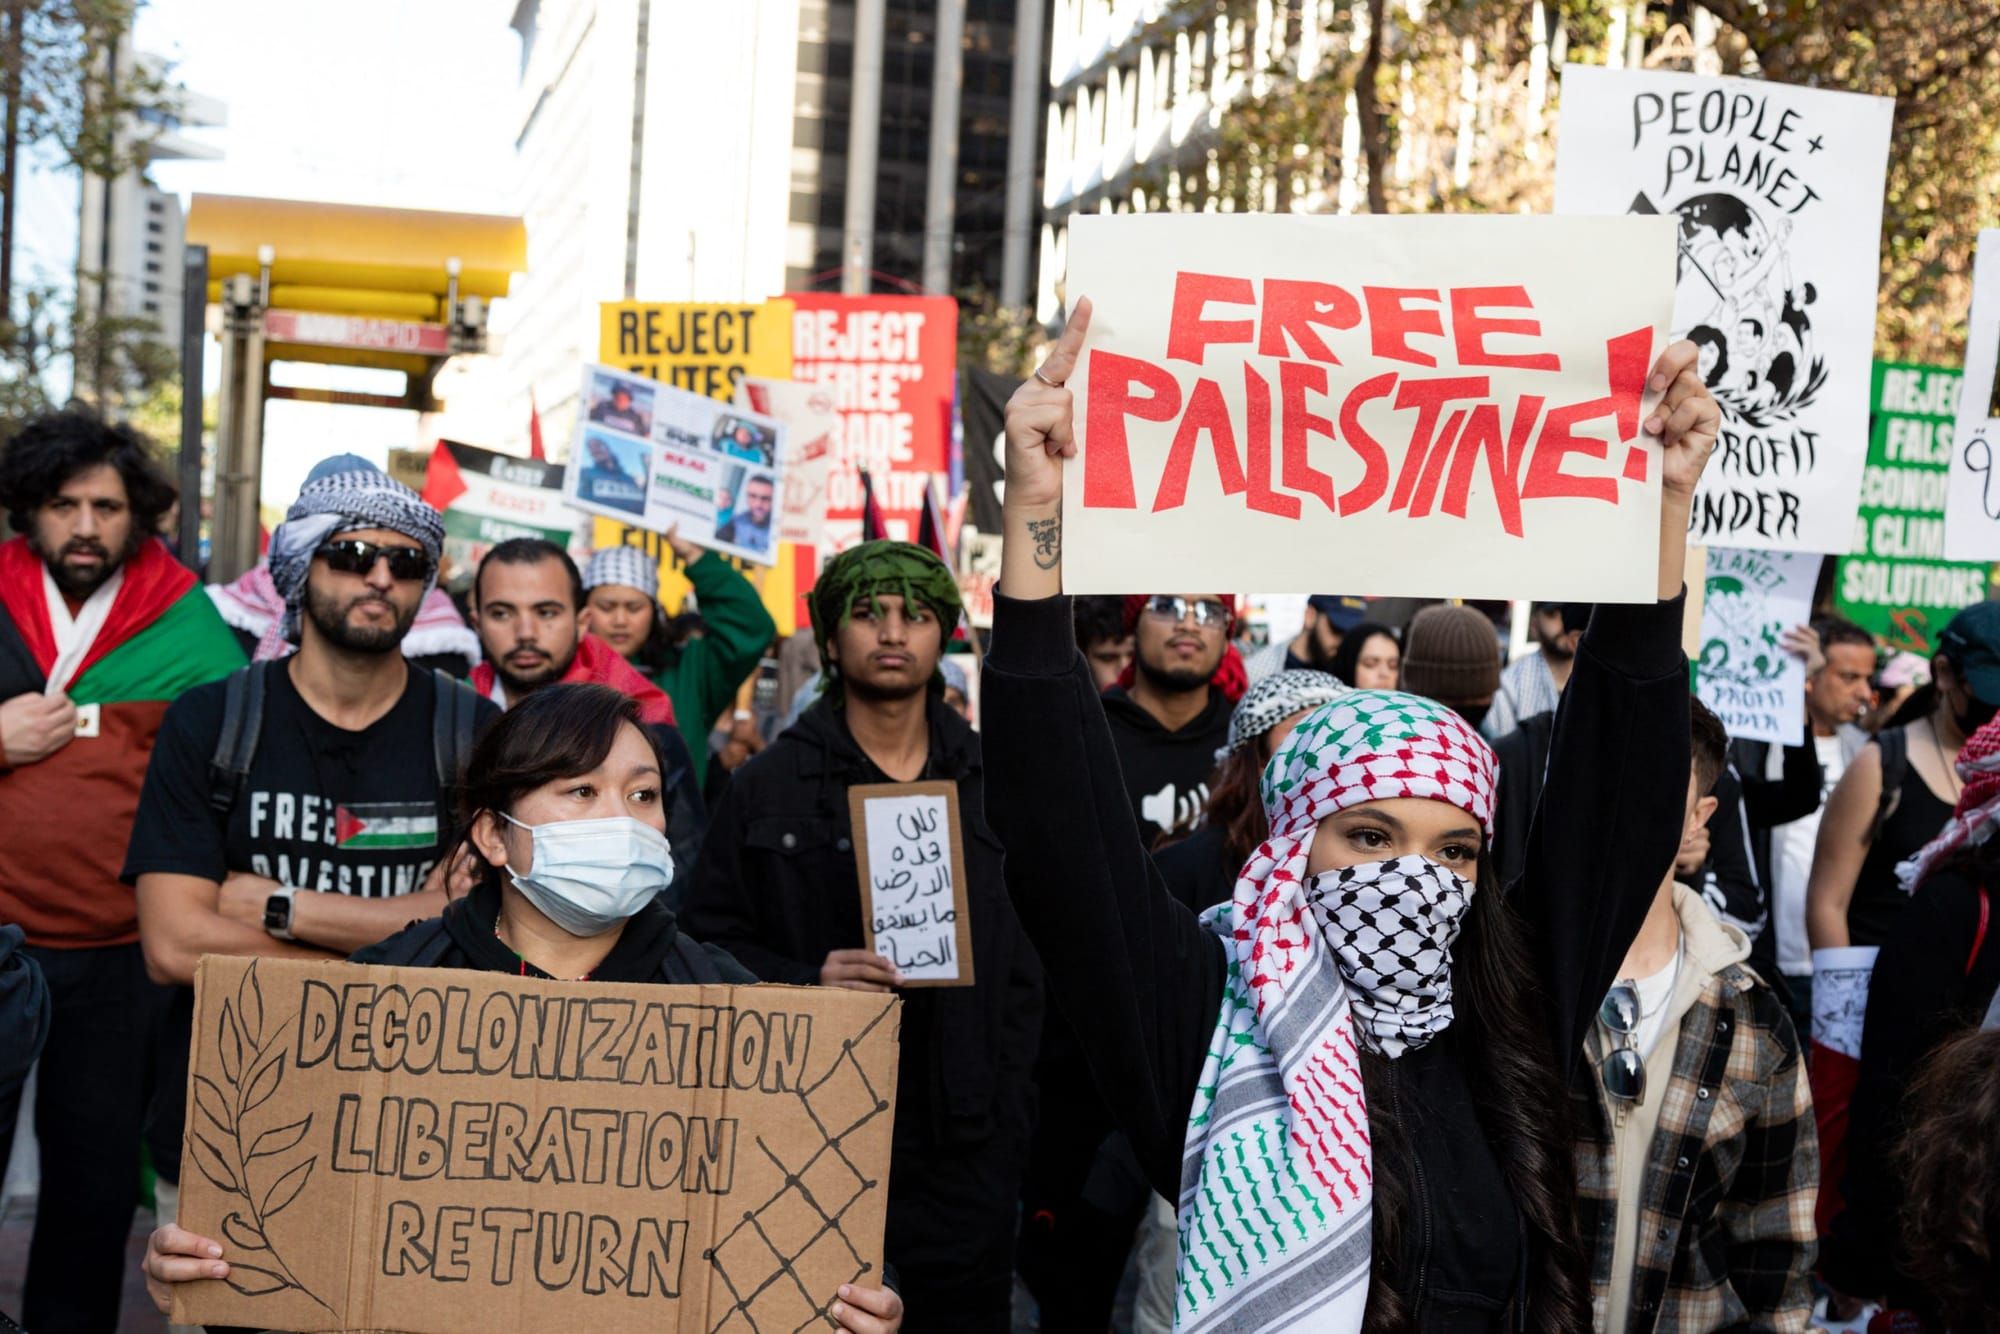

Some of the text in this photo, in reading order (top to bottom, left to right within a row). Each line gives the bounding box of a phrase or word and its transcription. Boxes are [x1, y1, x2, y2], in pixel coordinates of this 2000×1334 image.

[1633, 89, 1803, 151] PEOPLE
[1663, 142, 1822, 214] PLANET
[619, 310, 756, 355] REJECT
[793, 310, 925, 361] REJECT
[1167, 271, 1561, 372] FREE
[1083, 325, 1654, 539] PALESTINE!
[1711, 429, 1820, 478] ROFIT
[1842, 558, 1986, 608] SOLUTIONS
[1721, 710, 1780, 732] NDER
[295, 980, 812, 1094] DECOLONIZATION
[331, 1094, 738, 1195] LIBERATION
[382, 1200, 690, 1299] RETURN
